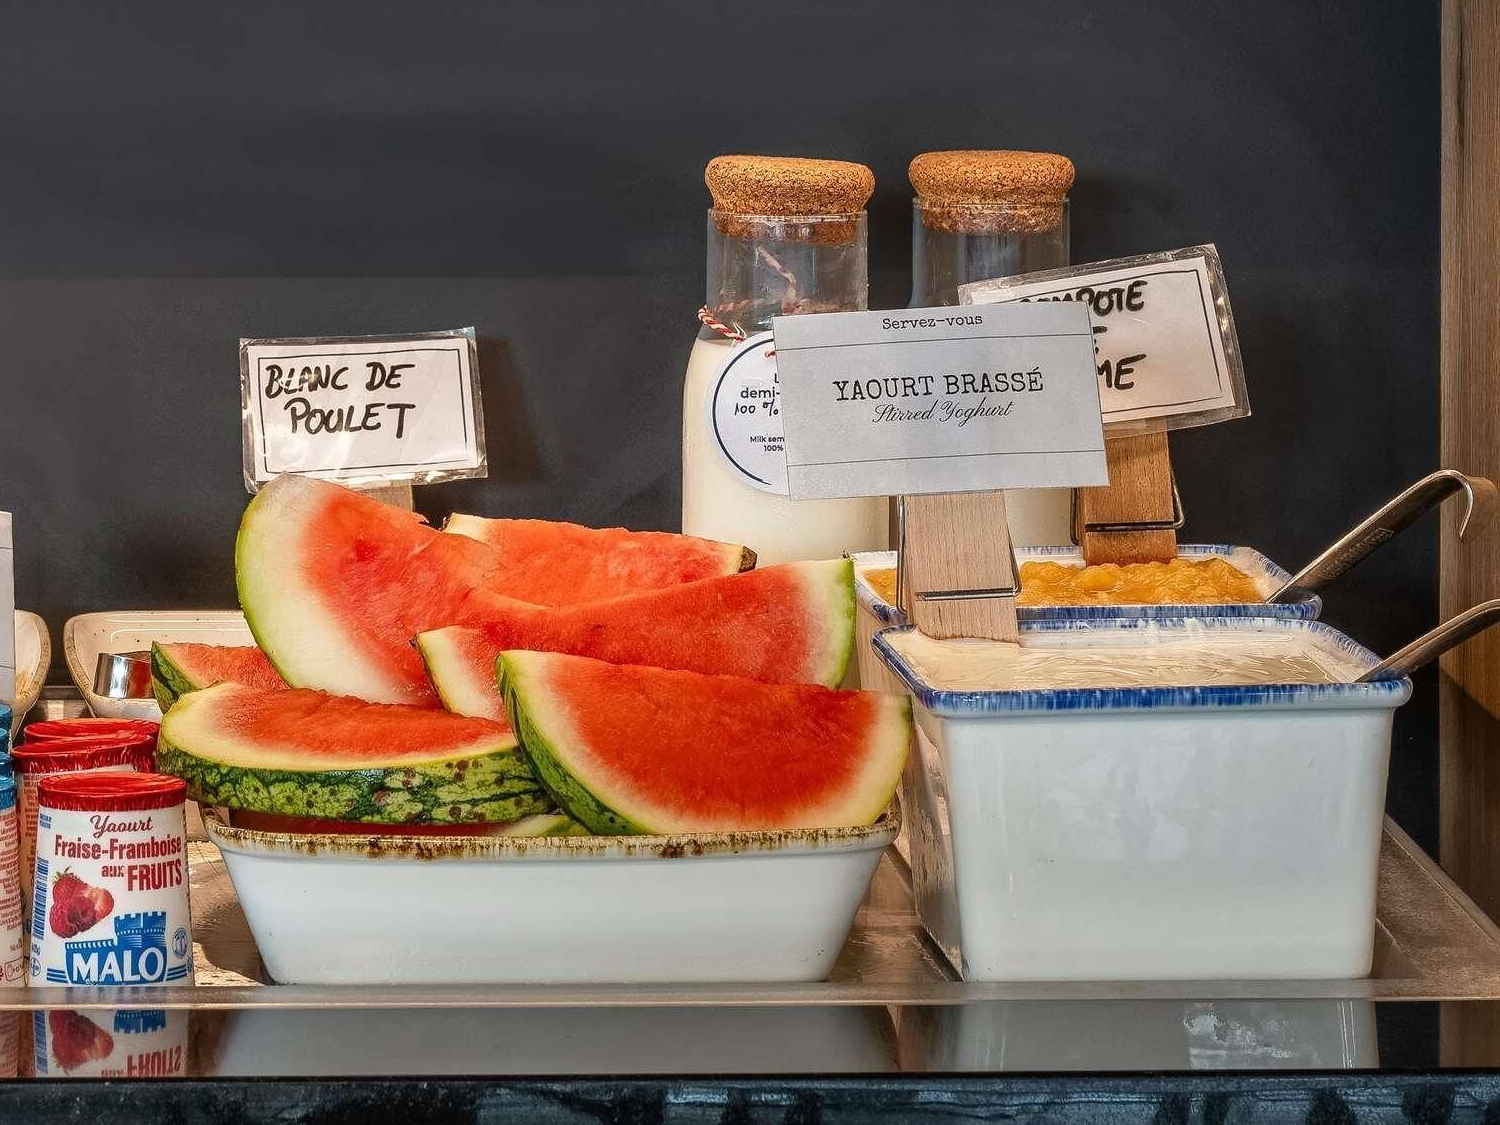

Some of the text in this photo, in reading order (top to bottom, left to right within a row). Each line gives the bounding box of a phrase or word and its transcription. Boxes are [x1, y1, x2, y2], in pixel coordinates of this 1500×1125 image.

[882, 313, 984, 331] Servez-vous
[264, 361, 416, 399] BLANC DE
[832, 366, 1044, 402] YAOURT BRASSÉ
[283, 396, 416, 439] POULET
[734, 403, 756, 416] 100
[871, 397, 1015, 427] Stirred Yoghurt
[750, 435, 768, 443] Milk
[764, 444, 784, 452] 100%
[89, 814, 153, 838] Yaourt
[54, 834, 182, 859] Fraise-Framboise
[101, 859, 182, 891] aux FRUITS
[72, 947, 164, 981] MALO
